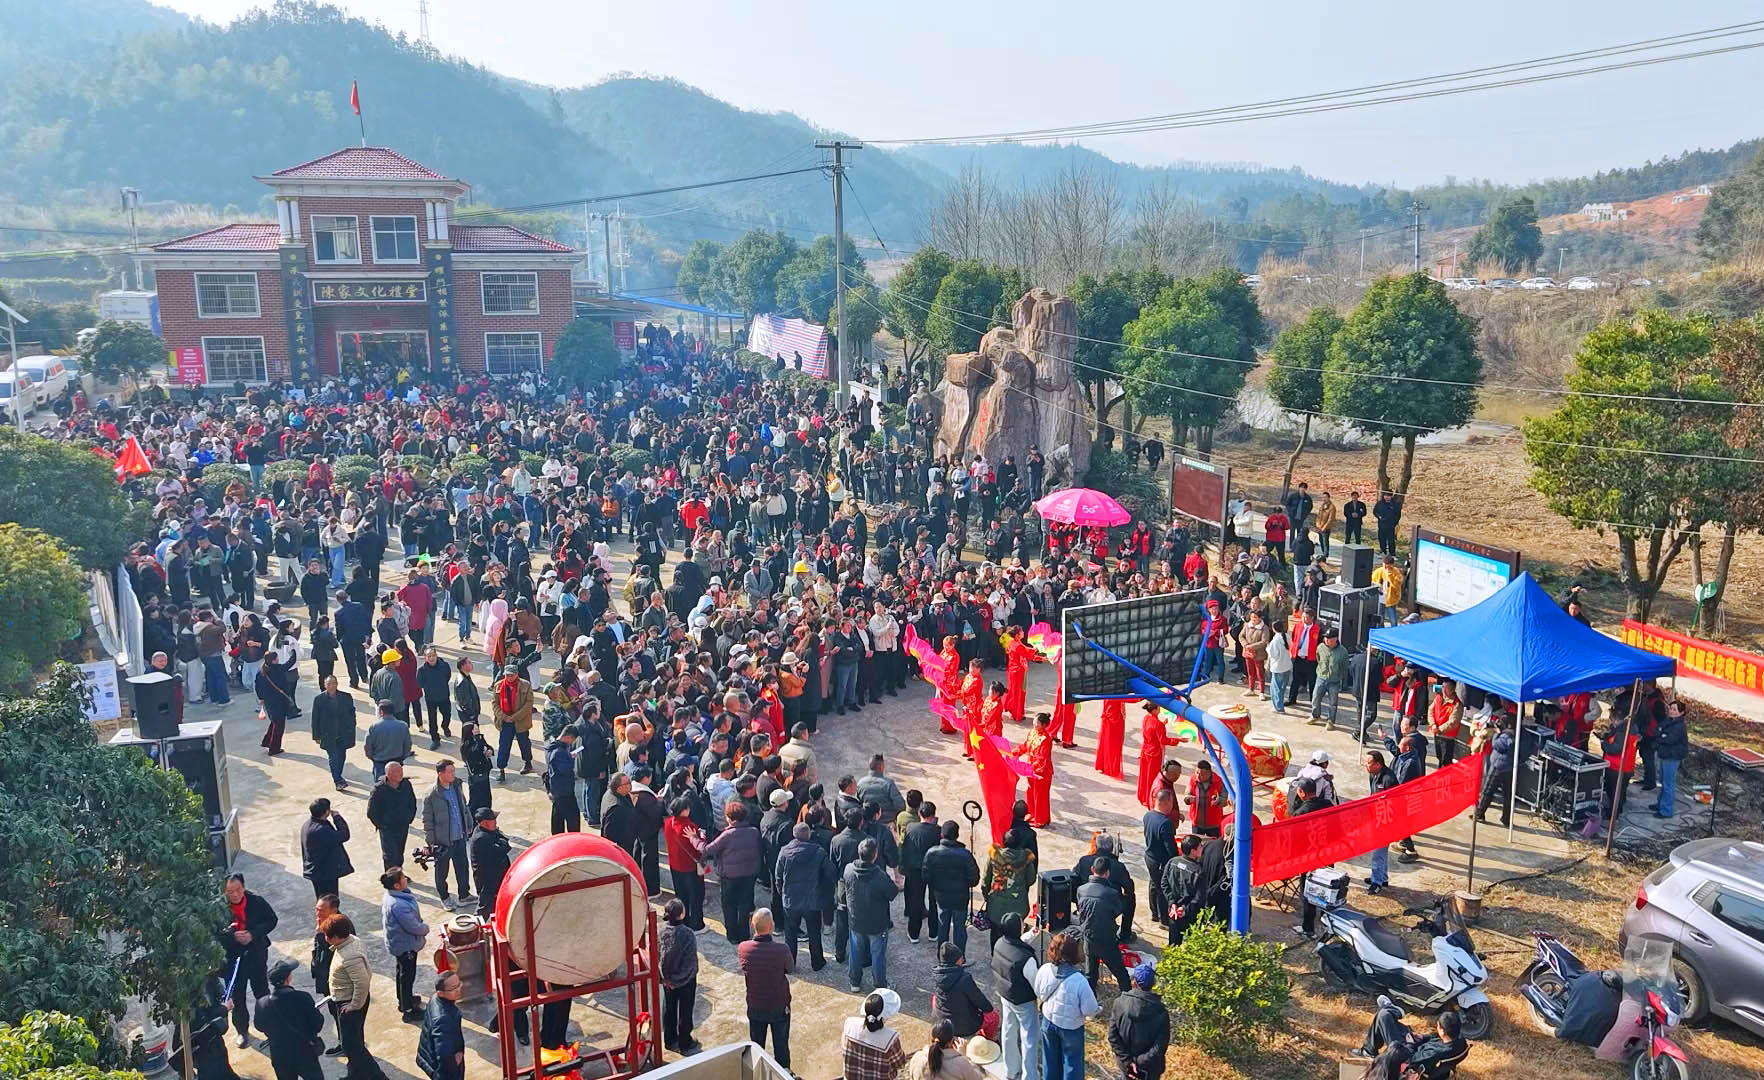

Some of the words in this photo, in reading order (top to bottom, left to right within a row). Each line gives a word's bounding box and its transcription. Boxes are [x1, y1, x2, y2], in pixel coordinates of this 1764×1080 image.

[321, 284, 418, 299] 陳家文化禮堂
